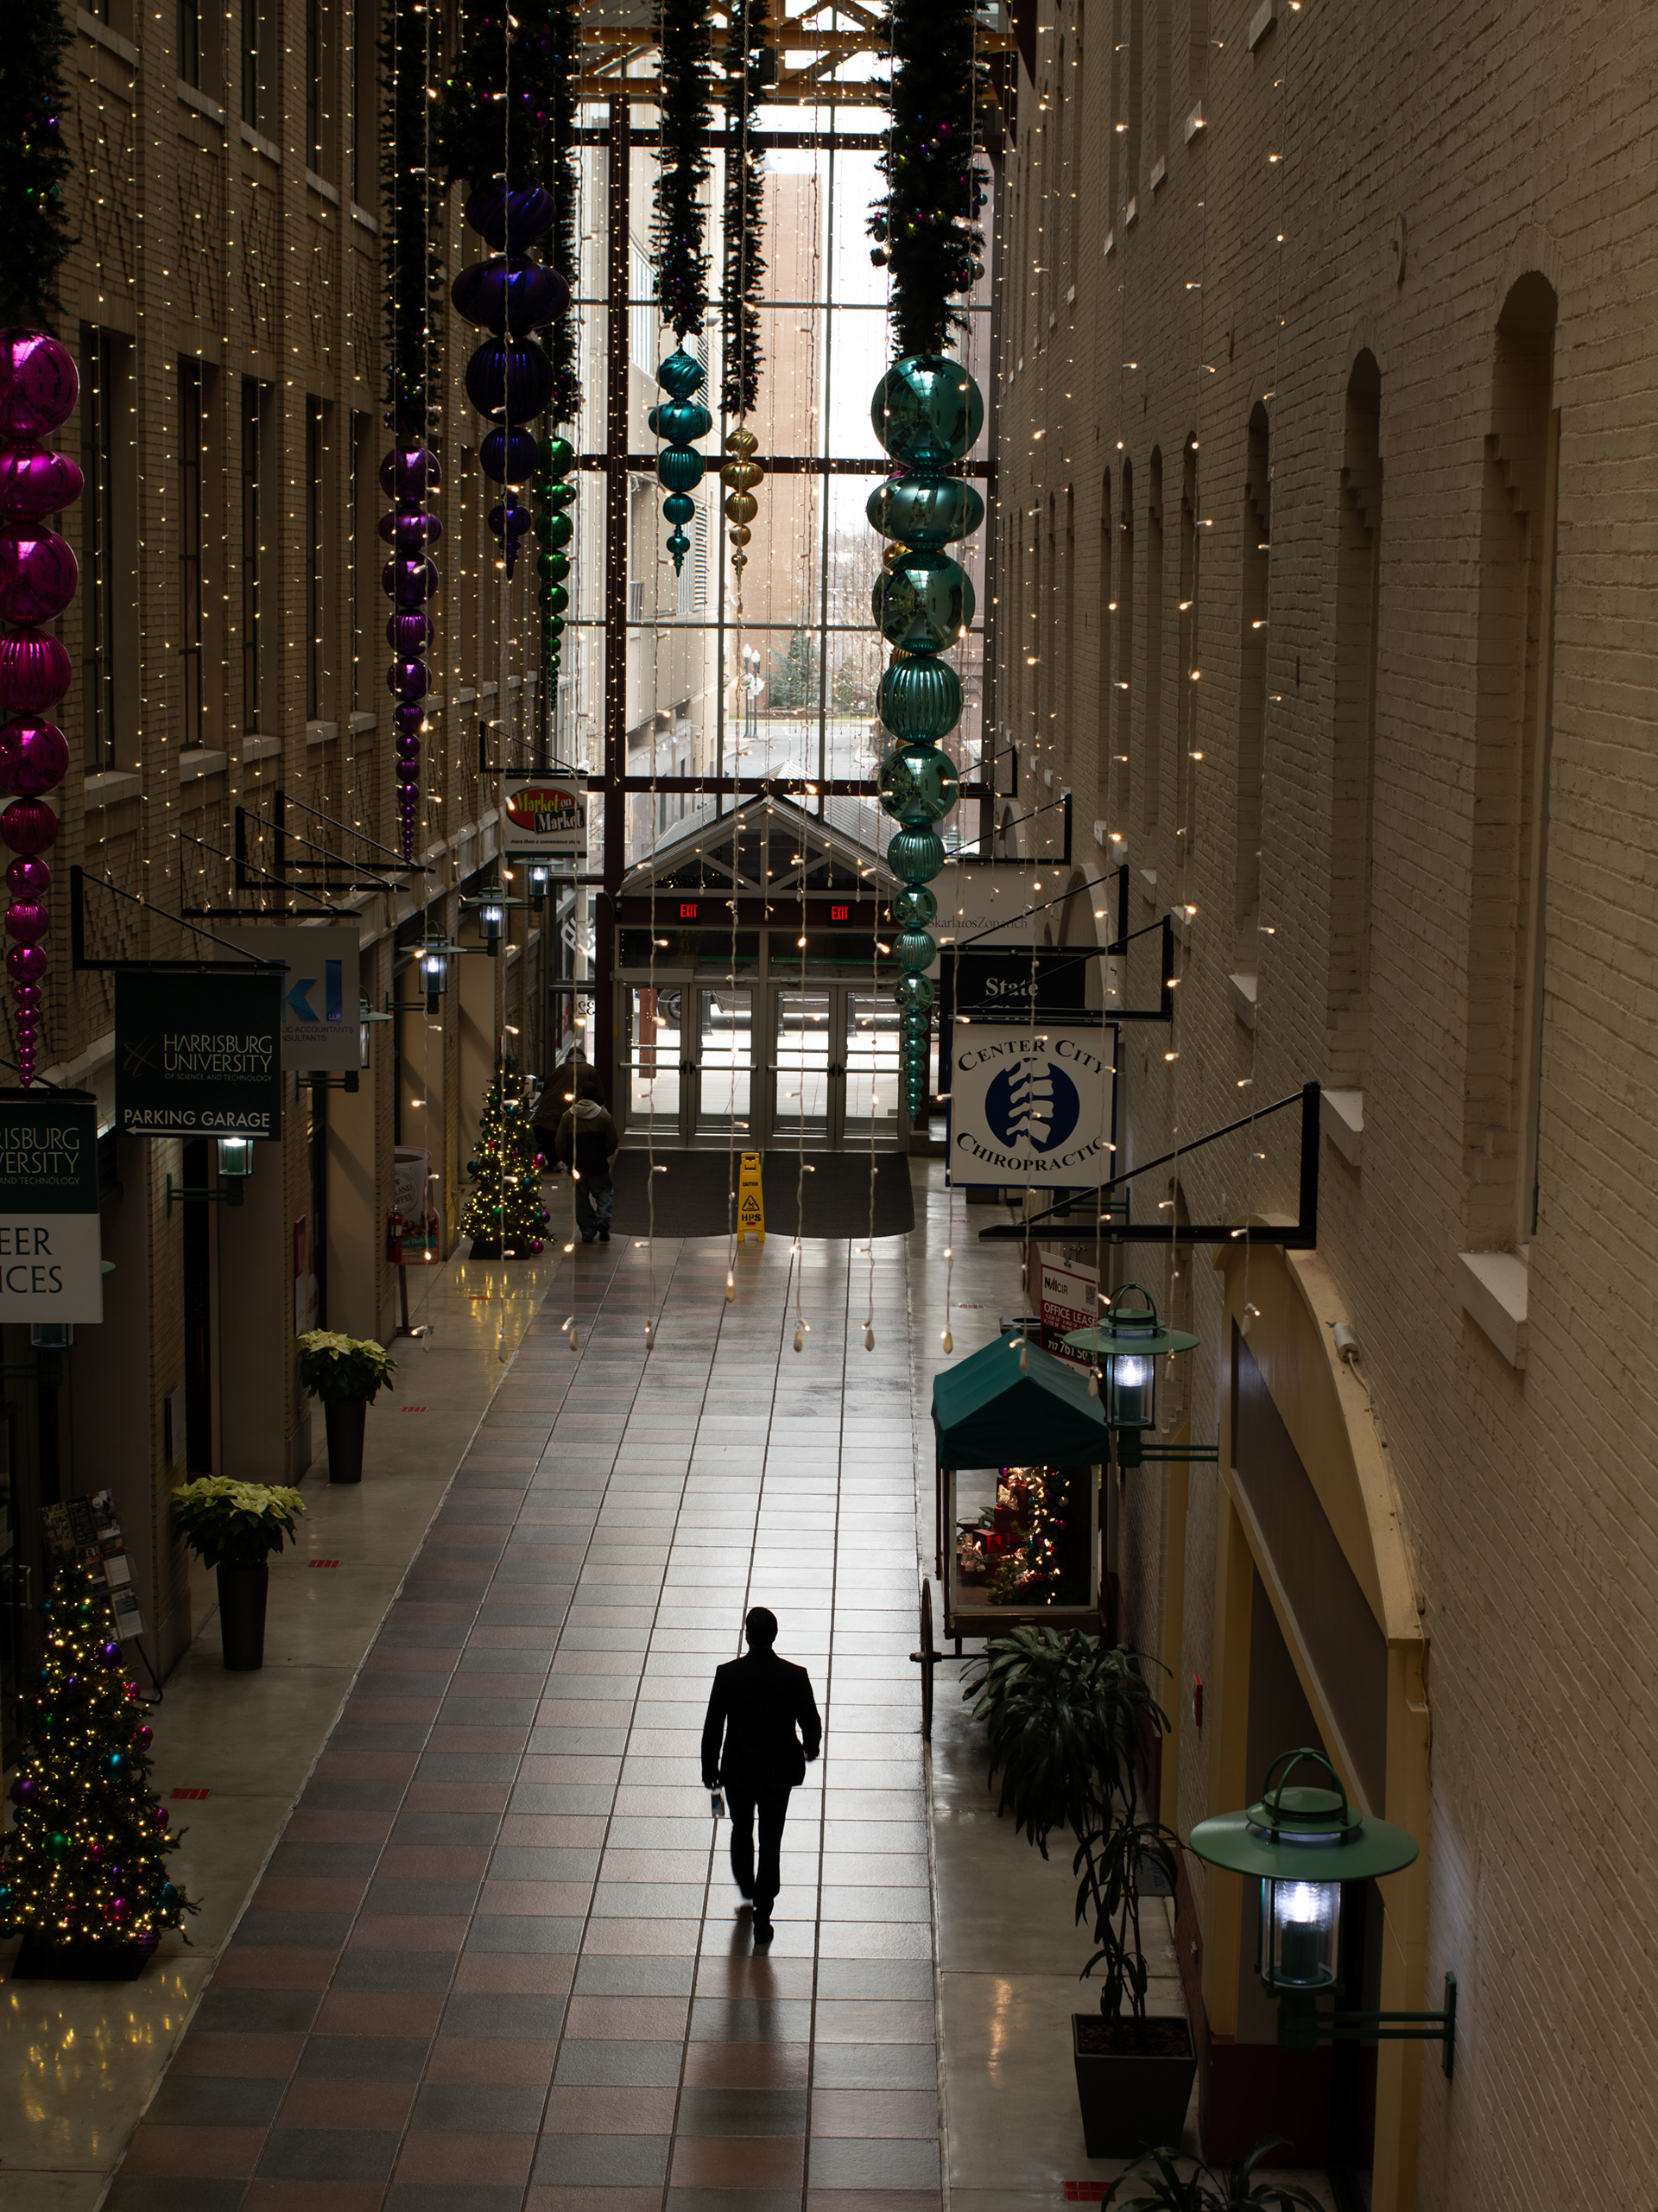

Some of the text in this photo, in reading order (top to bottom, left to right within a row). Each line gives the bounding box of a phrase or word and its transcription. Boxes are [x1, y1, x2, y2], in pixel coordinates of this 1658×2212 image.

[516, 792, 572, 813] Market on
[537, 809, 583, 832] Market
[680, 903, 698, 918] EXIT
[831, 906, 849, 920] EXIT
[985, 977, 1040, 997] State
[163, 1033, 273, 1054] HARRISBURG
[163, 1053, 273, 1073] UNIVERSITY
[959, 1039, 1104, 1075] CENTER CITY
[123, 1108, 270, 1128] PARKING GARAGE
[0, 1127, 80, 1150] ISBURG
[957, 1132, 1103, 1172] CHIROPRACTIC
[0, 1176, 80, 1185] AND TECHNOLOGY
[0, 1227, 54, 1255] EER
[1044, 1302, 1070, 1320] OFFICE
[1047, 1340, 1091, 1362] 717 761 50
